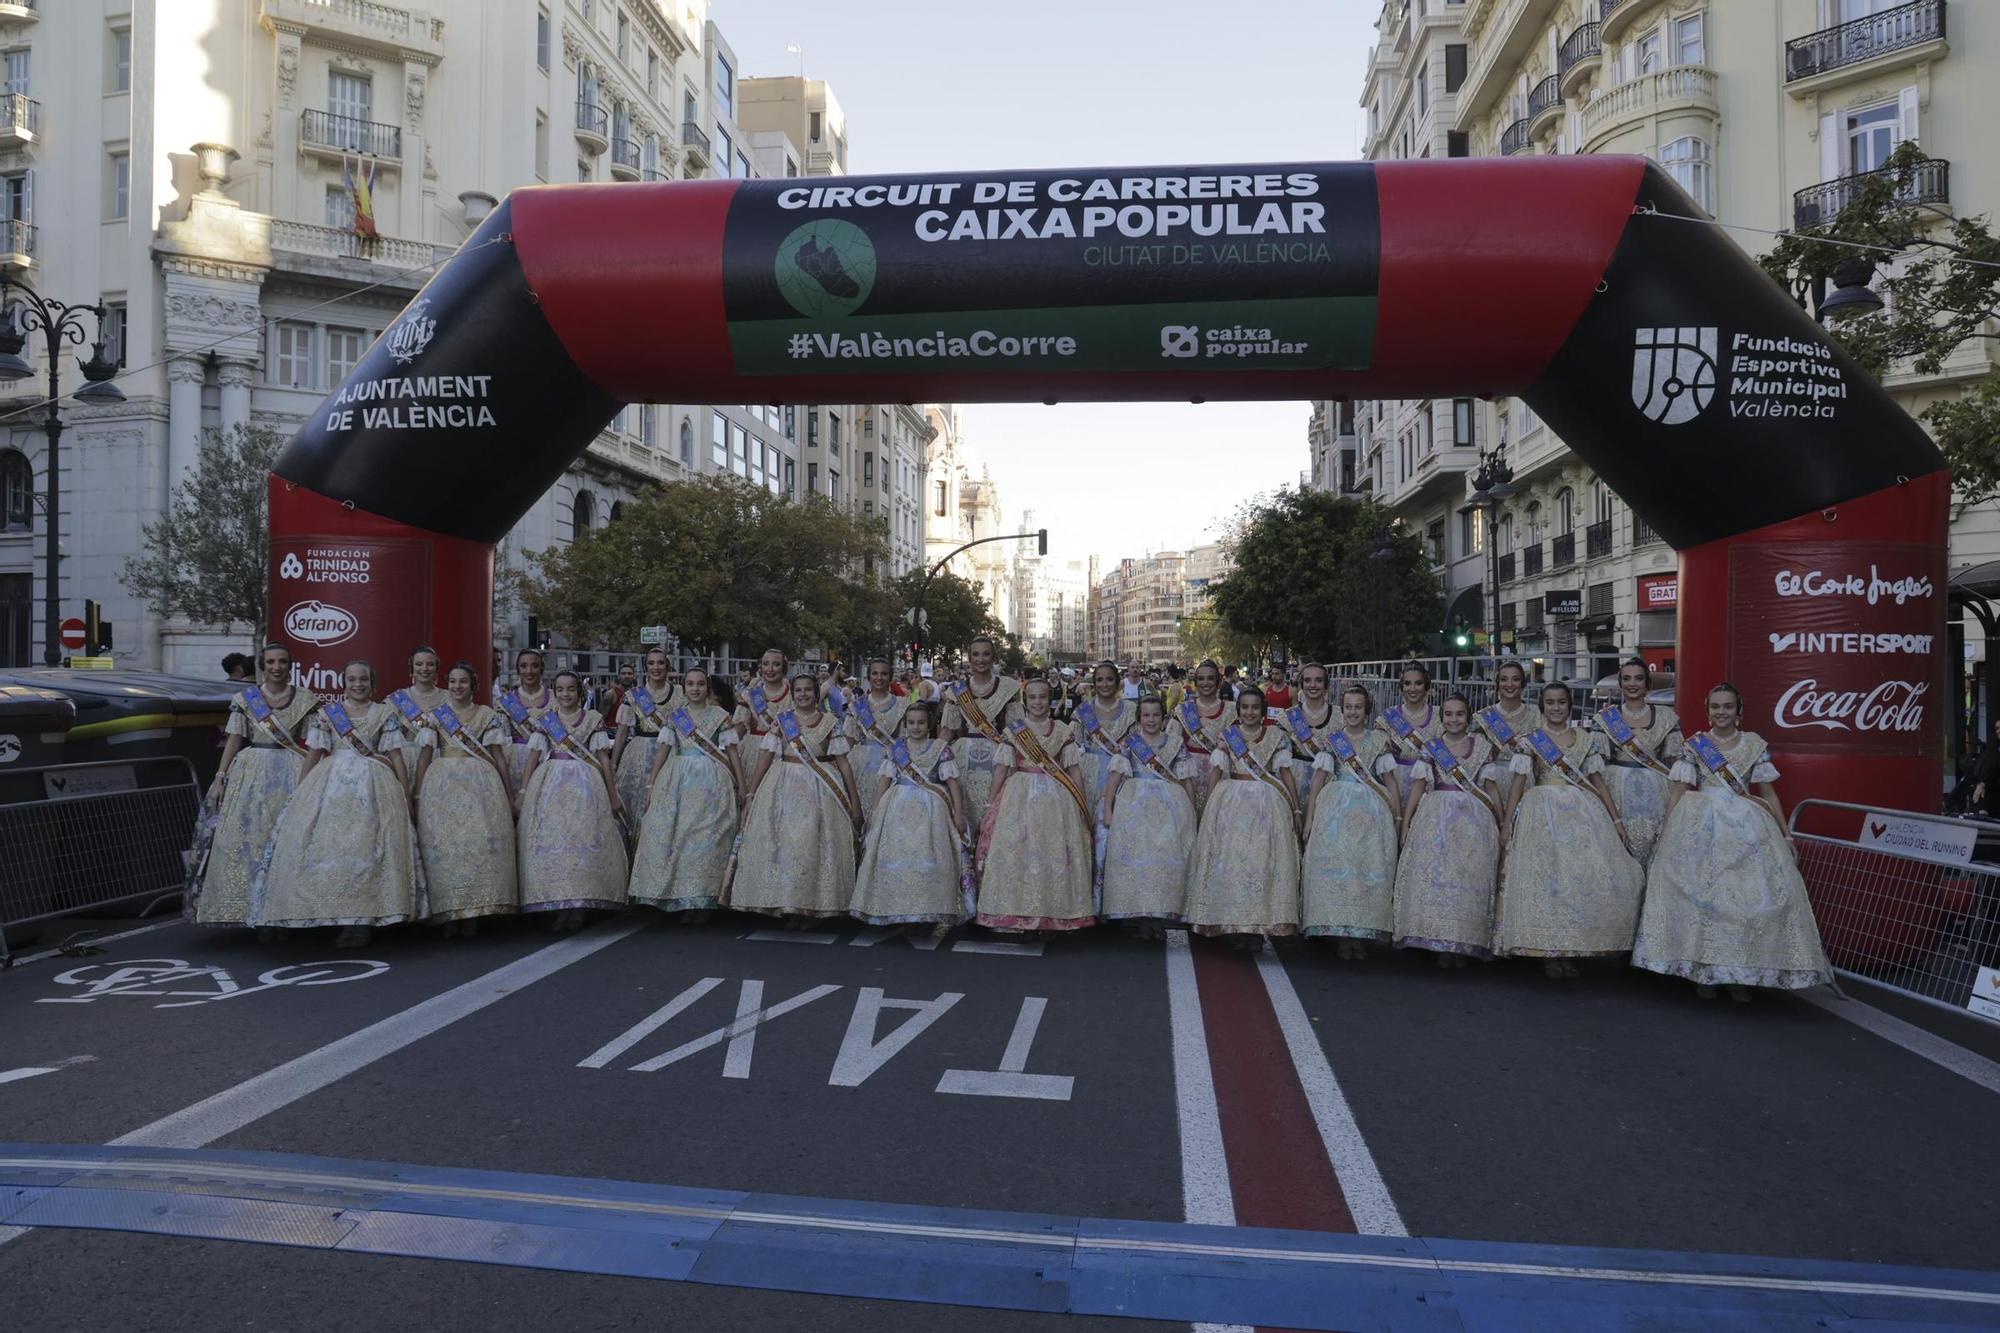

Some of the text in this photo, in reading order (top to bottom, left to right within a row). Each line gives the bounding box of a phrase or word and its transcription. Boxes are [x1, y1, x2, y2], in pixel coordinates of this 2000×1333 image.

[777, 173, 1319, 210] CIRCUIT DE CARRERES
[914, 201, 1326, 242] CAIXA POPULAR
[1083, 238, 1332, 266] CIUTAT DE VALÈNCIA
[787, 329, 1078, 359] #ValènciaCorre
[1206, 325, 1272, 341] caixa
[1206, 340, 1309, 358] popular
[1731, 333, 1832, 360] Fundació
[1731, 355, 1841, 379] Esportiva
[334, 375, 491, 406] AJUNTAMENT
[1730, 377, 1847, 400] Municipal
[326, 401, 497, 431] DE VALÈNCIA
[1729, 398, 1835, 418] València
[306, 549, 370, 558] FUNDACIÓN
[306, 559, 370, 571] TRINIDAD
[306, 571, 370, 583] ALFONSO
[1775, 564, 1933, 606] El Corte Inglés
[1651, 588, 1677, 599] GRAT
[290, 612, 349, 632] Serrano
[1799, 633, 1934, 654] INTERSPORT
[1773, 678, 1929, 732] Coca-Cola
[1884, 833, 1968, 857] CIUDAD DEL RUNNING
[576, 976, 1075, 1100] TAXI
